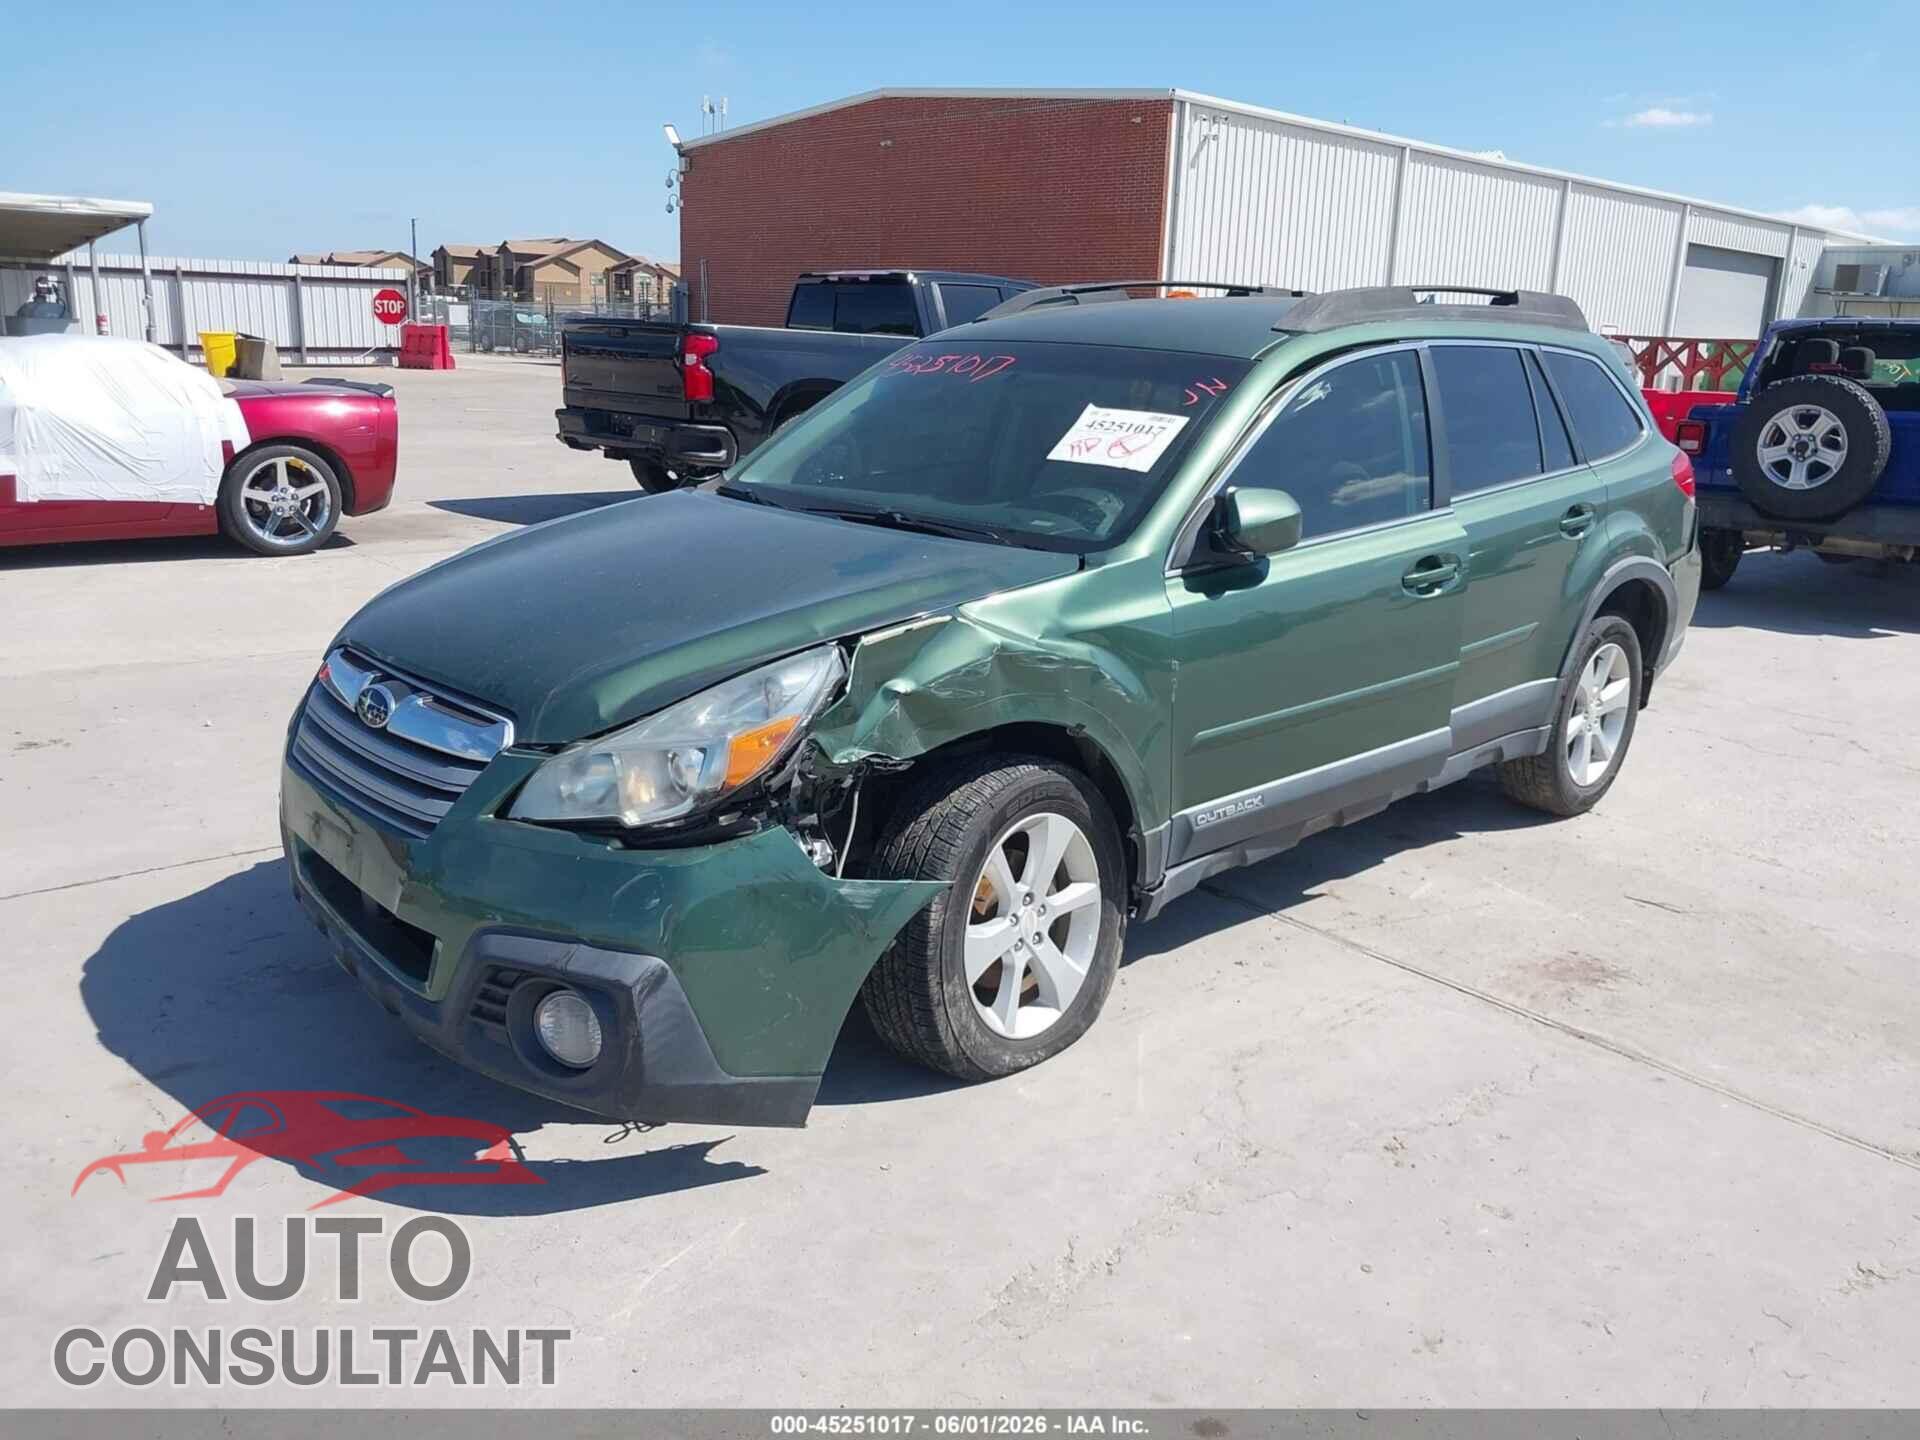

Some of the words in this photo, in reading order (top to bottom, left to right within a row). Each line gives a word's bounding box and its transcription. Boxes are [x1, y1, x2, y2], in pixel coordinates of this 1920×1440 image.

[375, 300, 405, 314] STOP
[1086, 419, 1168, 435] 45251017
[1196, 794, 1264, 825] OUTBACK
